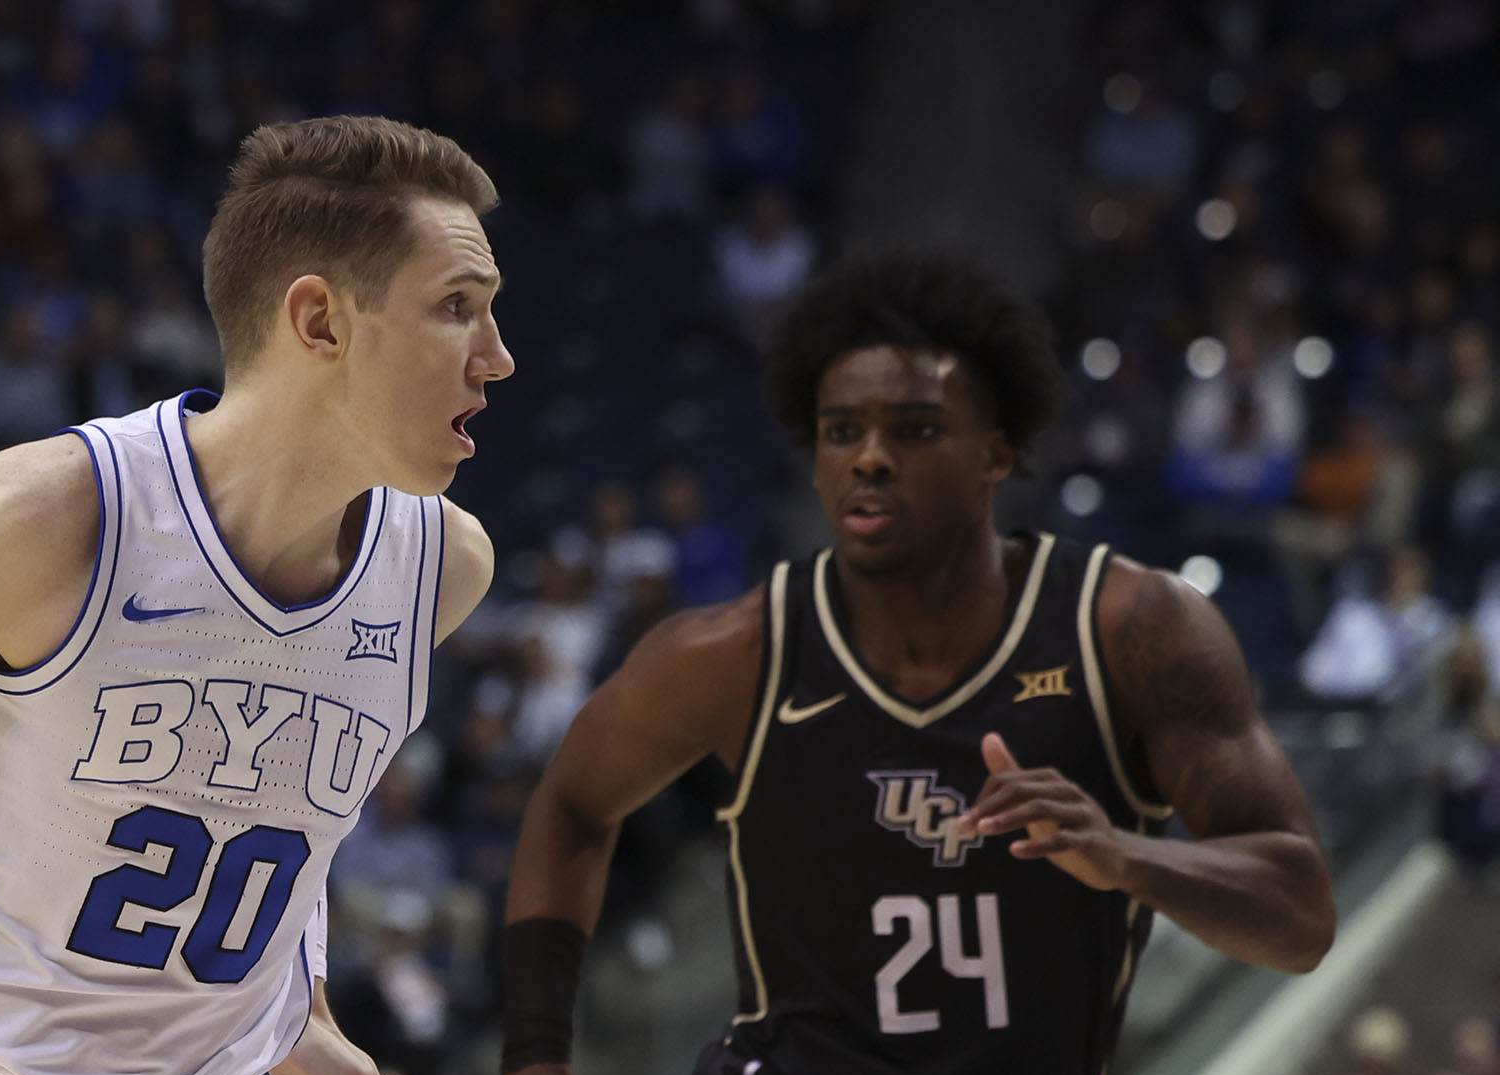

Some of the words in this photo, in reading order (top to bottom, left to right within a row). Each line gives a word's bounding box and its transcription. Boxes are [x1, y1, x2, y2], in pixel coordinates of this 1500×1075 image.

[346, 618, 401, 663] XII
[1013, 665, 1073, 702] XII
[71, 679, 392, 818] BYU
[65, 804, 312, 984] 20
[870, 892, 1010, 1035] 24
